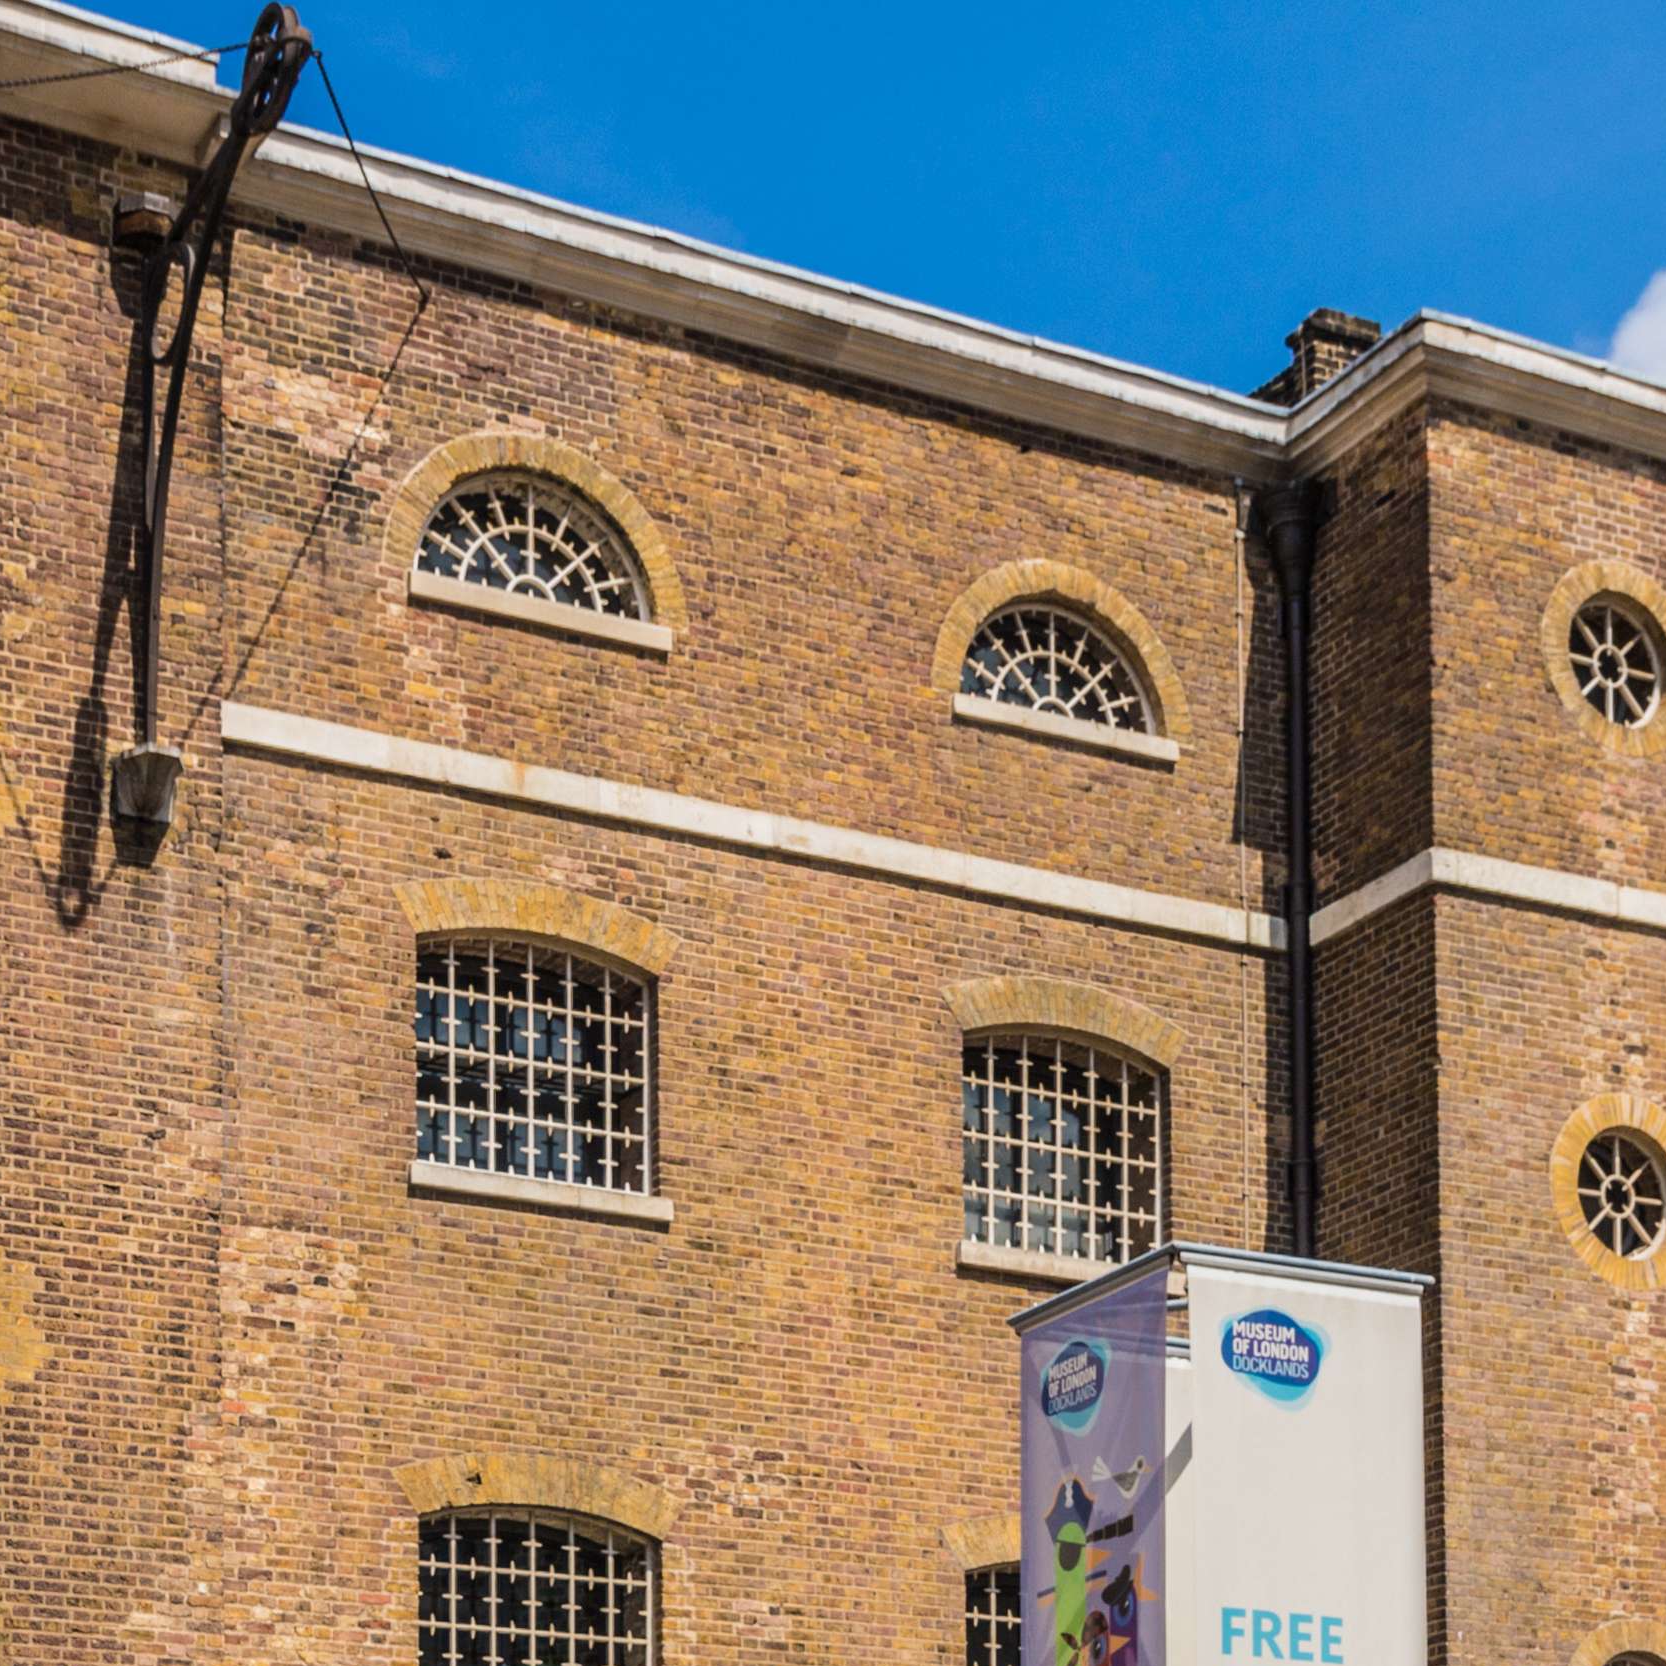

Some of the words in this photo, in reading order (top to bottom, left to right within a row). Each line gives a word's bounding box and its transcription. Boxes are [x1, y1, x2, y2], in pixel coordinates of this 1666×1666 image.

[1233, 1321, 1296, 1343] MUSEUM
[1233, 1337, 1251, 1355] OF
[1253, 1340, 1310, 1363] LONDON
[1048, 1351, 1088, 1384] MUSEUM
[1048, 1380, 1061, 1399] OF
[1061, 1364, 1098, 1394] LONDON
[1233, 1355, 1310, 1379] DOCKLANDS
[1221, 1607, 1345, 1665] FREE
